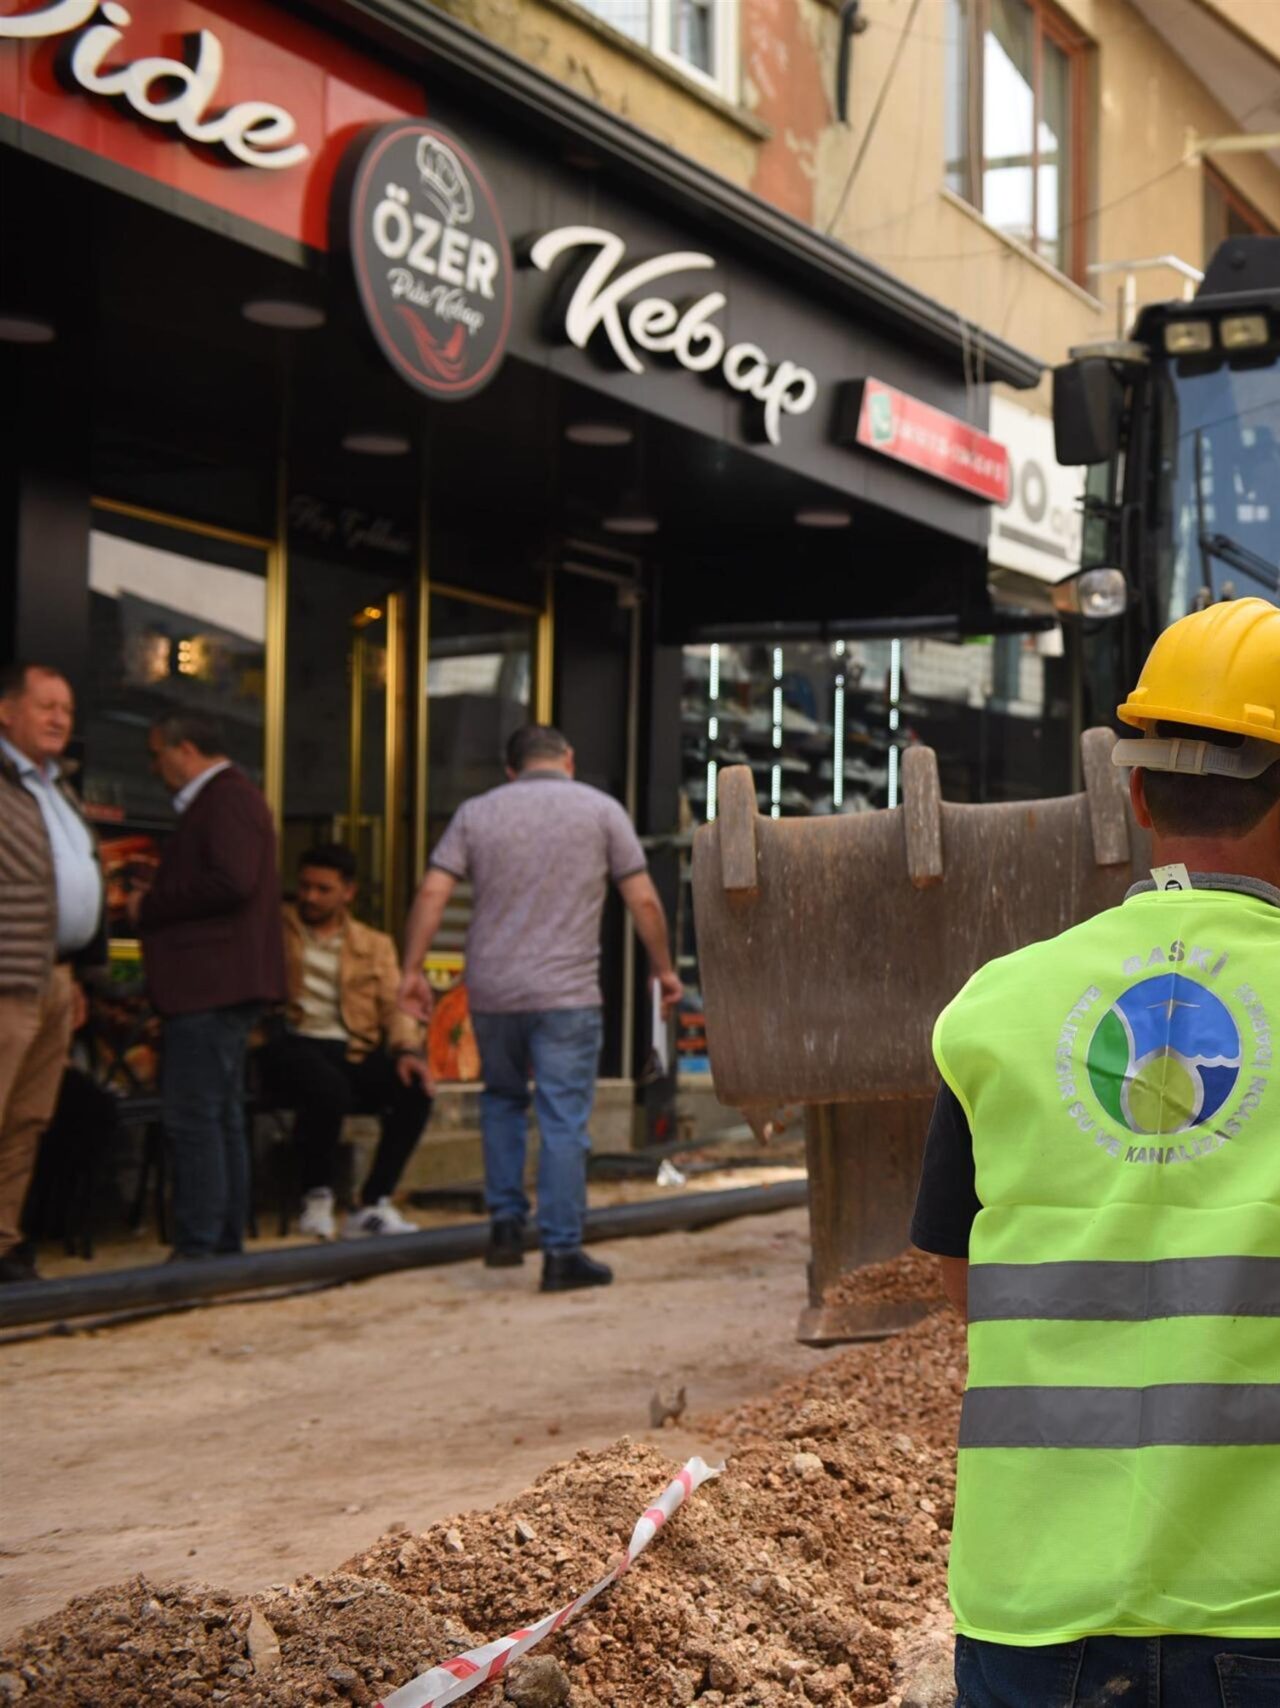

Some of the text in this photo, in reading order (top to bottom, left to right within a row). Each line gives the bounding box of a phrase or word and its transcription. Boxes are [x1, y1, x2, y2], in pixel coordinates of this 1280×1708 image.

[373, 183, 498, 299] ÖZER
[530, 225, 818, 446] Kebap
[1068, 1101, 1095, 1132] SU
[1095, 1129, 1122, 1157] VE
